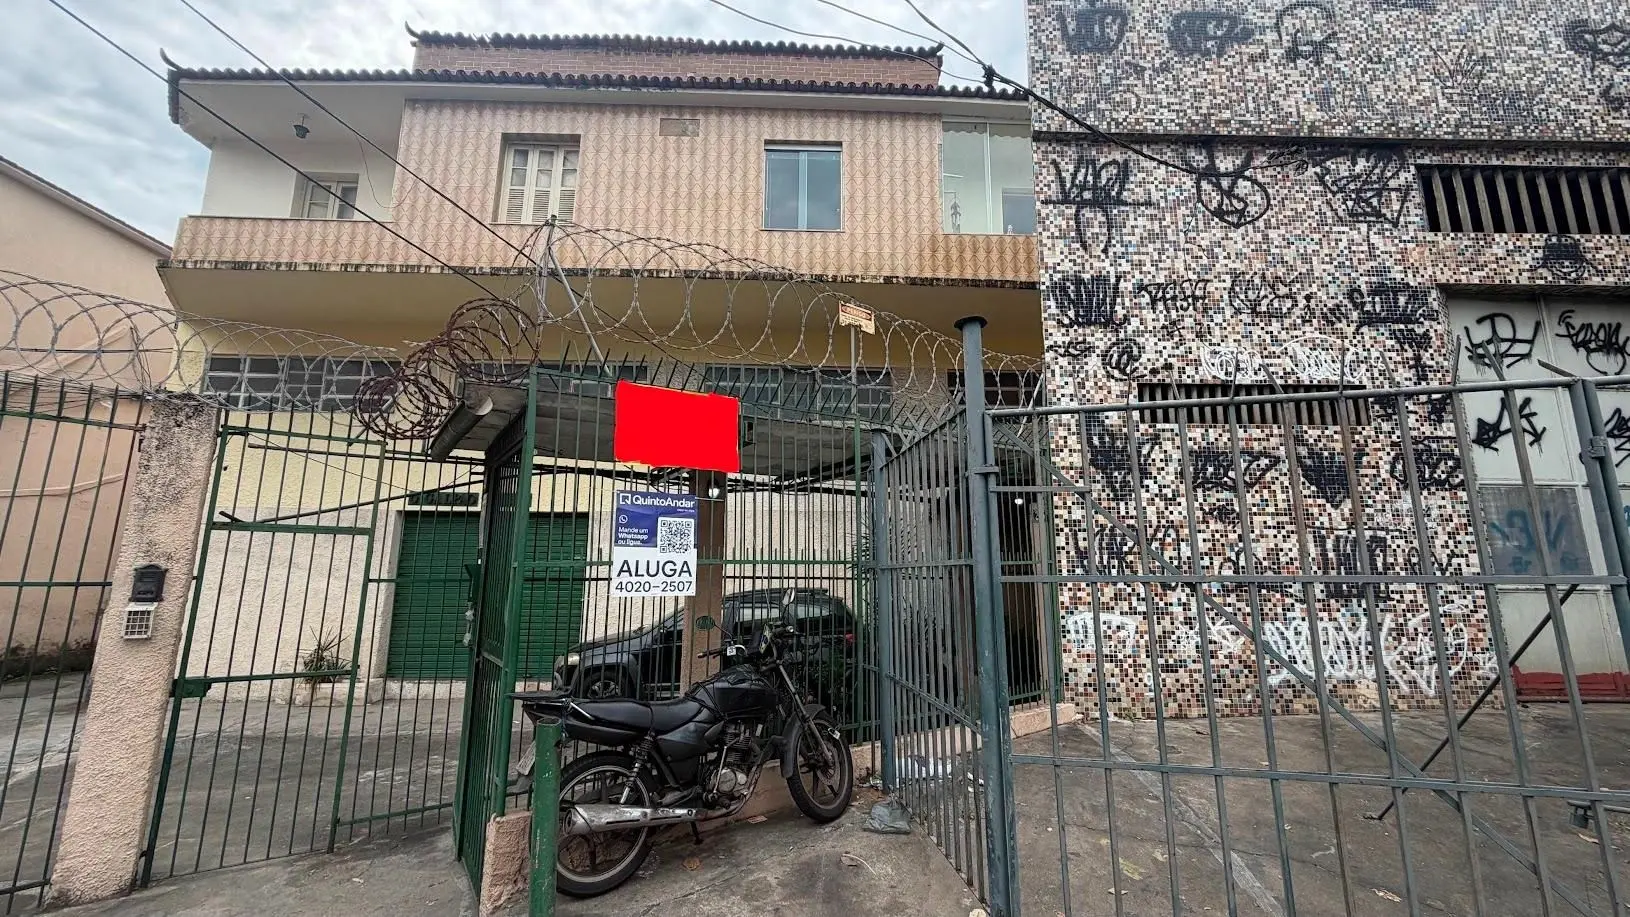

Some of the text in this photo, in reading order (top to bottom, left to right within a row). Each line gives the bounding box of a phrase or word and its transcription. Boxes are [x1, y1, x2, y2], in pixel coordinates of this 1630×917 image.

[632, 495, 695, 508] QuintoAndar
[619, 526, 639, 534] Mande
[616, 560, 693, 578] ALUGA
[615, 580, 693, 593] 4020-2507
